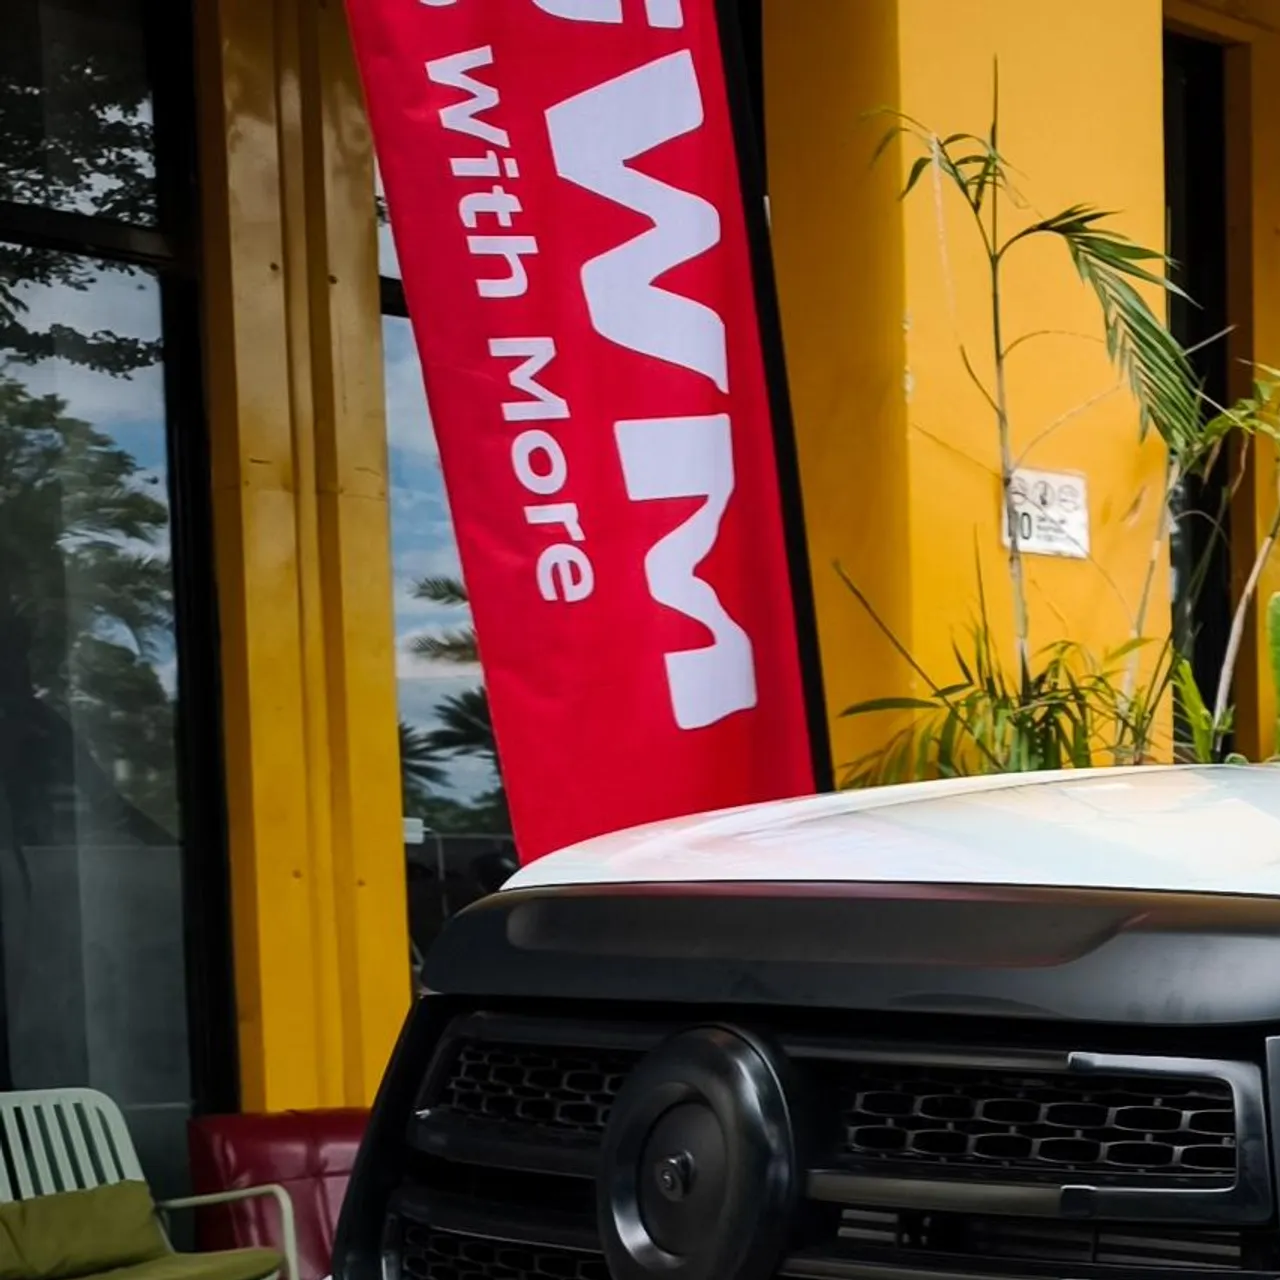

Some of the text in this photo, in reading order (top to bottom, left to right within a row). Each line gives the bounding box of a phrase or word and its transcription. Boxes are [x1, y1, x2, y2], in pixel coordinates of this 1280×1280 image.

[425, 45, 594, 603] With More
[531, 0, 757, 730] WM
